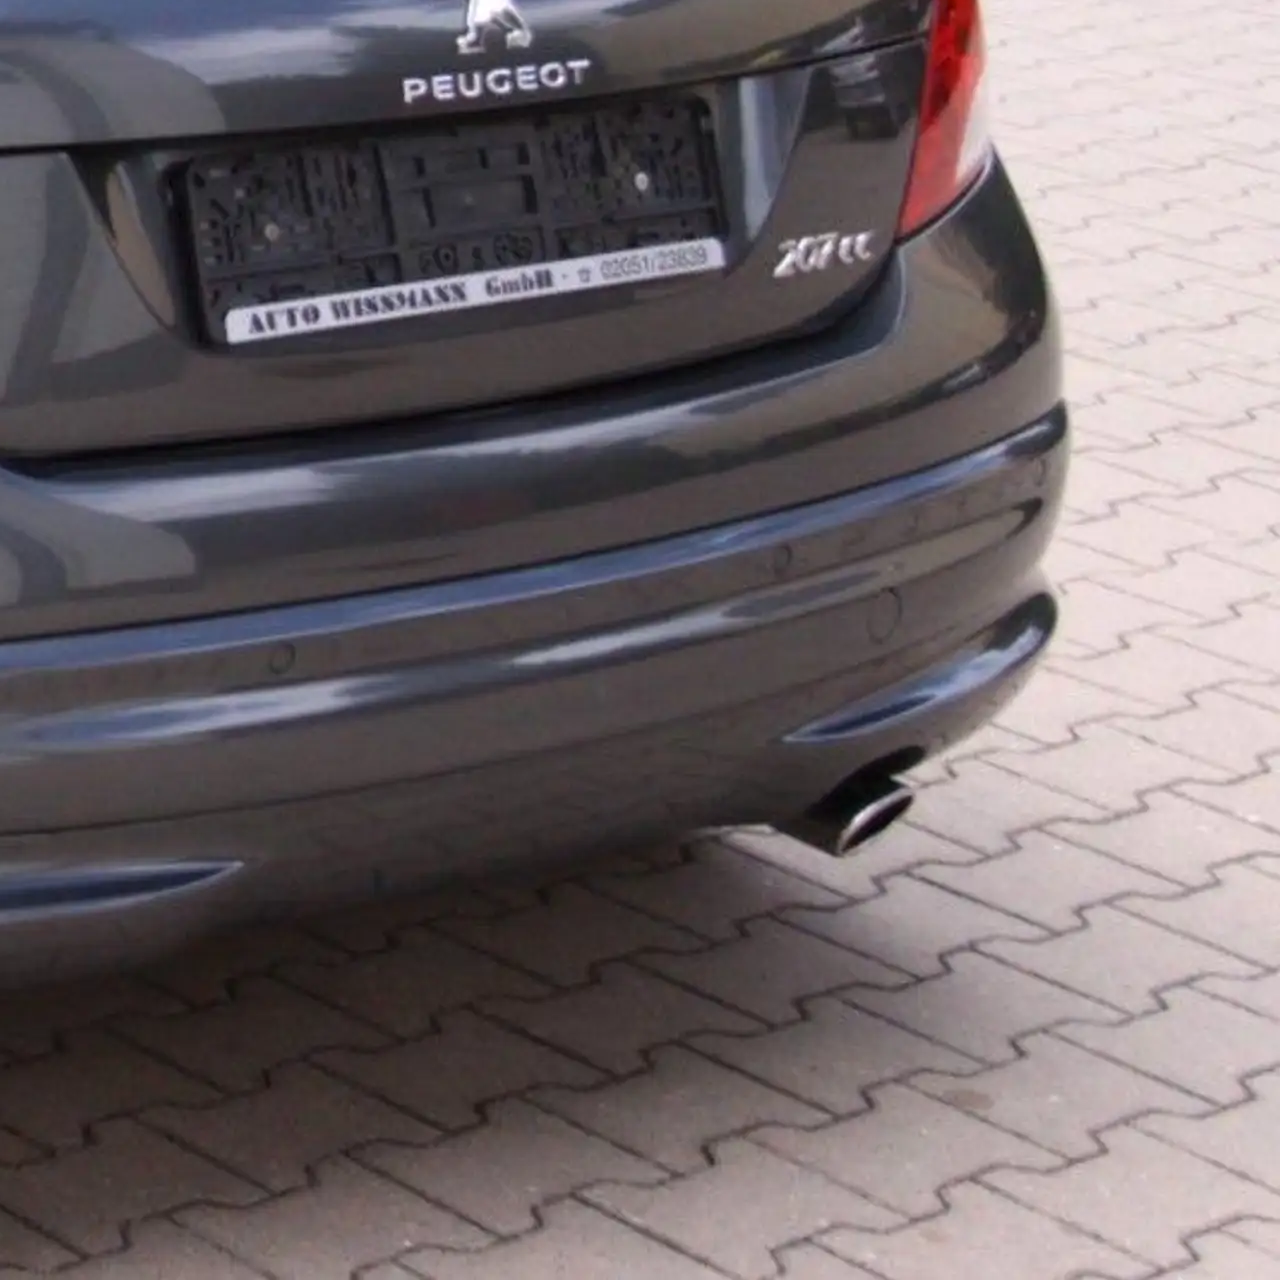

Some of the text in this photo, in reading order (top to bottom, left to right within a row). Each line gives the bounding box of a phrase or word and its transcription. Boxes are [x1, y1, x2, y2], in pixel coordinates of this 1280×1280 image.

[402, 59, 591, 104] PEUGEOT
[248, 302, 321, 335] AUTO
[329, 280, 469, 321] WISSMANN
[484, 269, 554, 297] GmbH
